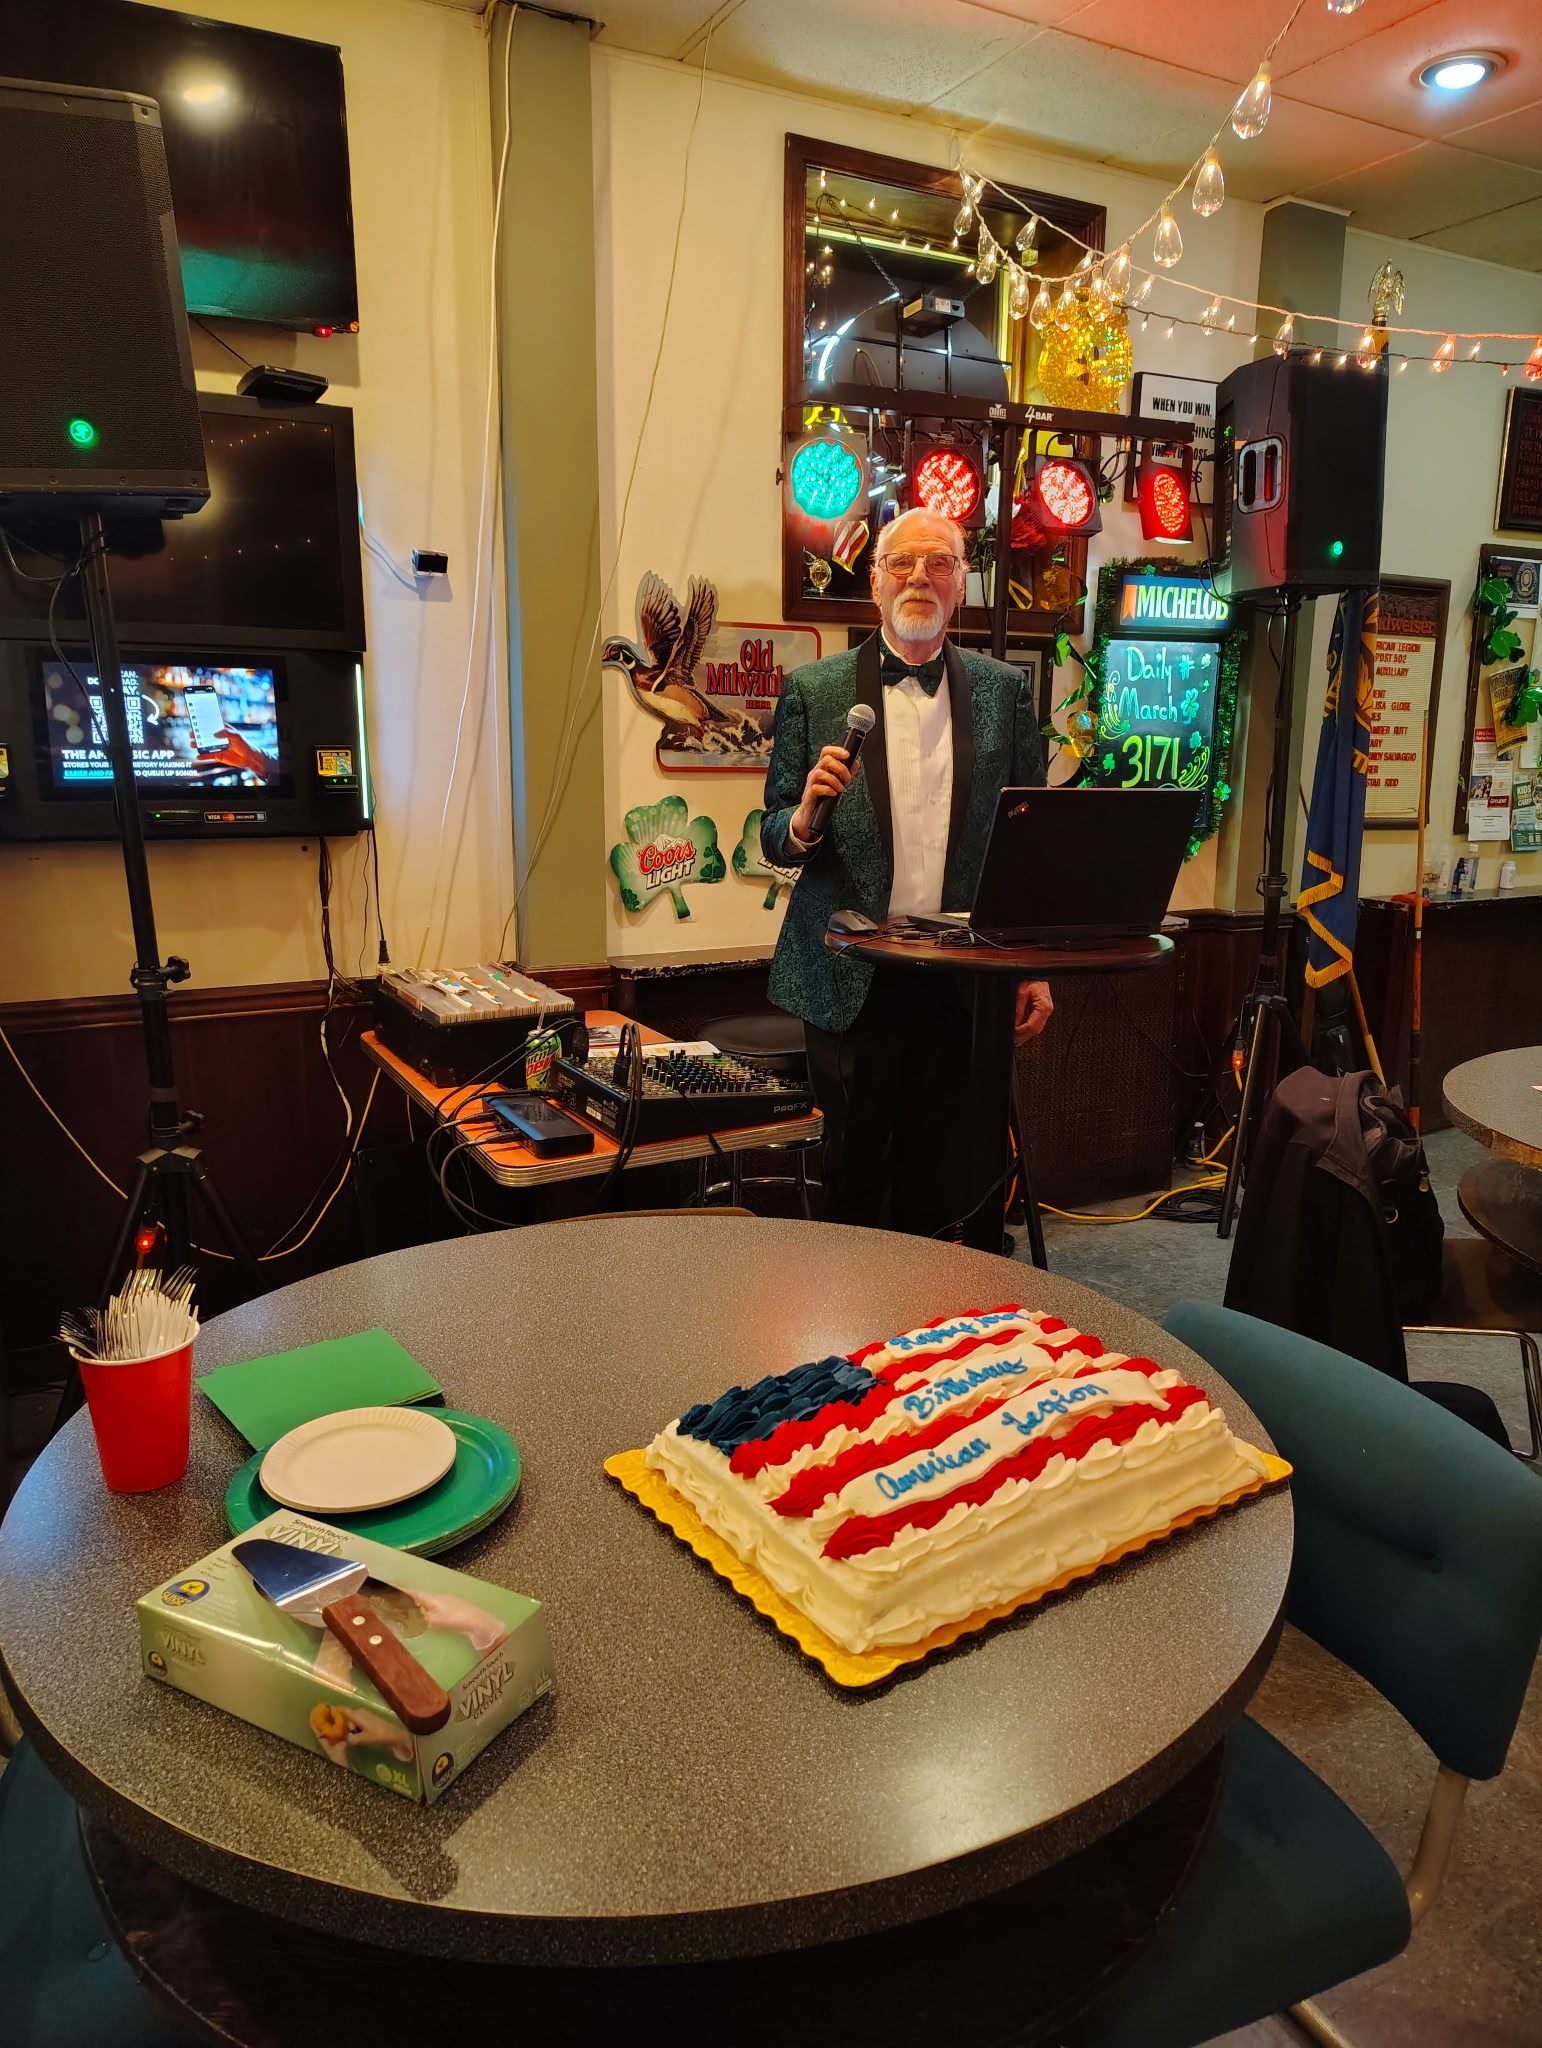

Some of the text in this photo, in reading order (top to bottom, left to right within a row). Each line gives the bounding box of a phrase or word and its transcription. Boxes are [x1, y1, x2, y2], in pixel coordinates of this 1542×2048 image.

[1153, 397, 1175, 412] WHEN
[1178, 400, 1193, 414] YOU
[1137, 585, 1228, 621] MICHELOB
[1378, 614, 1434, 634] dweiser
[740, 639, 774, 672] Old
[1127, 646, 1195, 694] Daily #
[1375, 653, 1407, 664] POST 502
[705, 662, 782, 697] Milwau
[746, 700, 771, 709] BEER
[1118, 686, 1178, 722] March
[62, 750, 86, 759] THE
[151, 750, 175, 759] APP
[1121, 735, 1181, 788] 3171
[637, 839, 695, 874] Coors
[646, 859, 695, 889] LIGHT
[904, 1357, 1028, 1419] Birthday
[875, 1384, 1108, 1499] American Legion
[460, 1662, 514, 1718] VINYL
[473, 1690, 503, 1719] GLOVES
